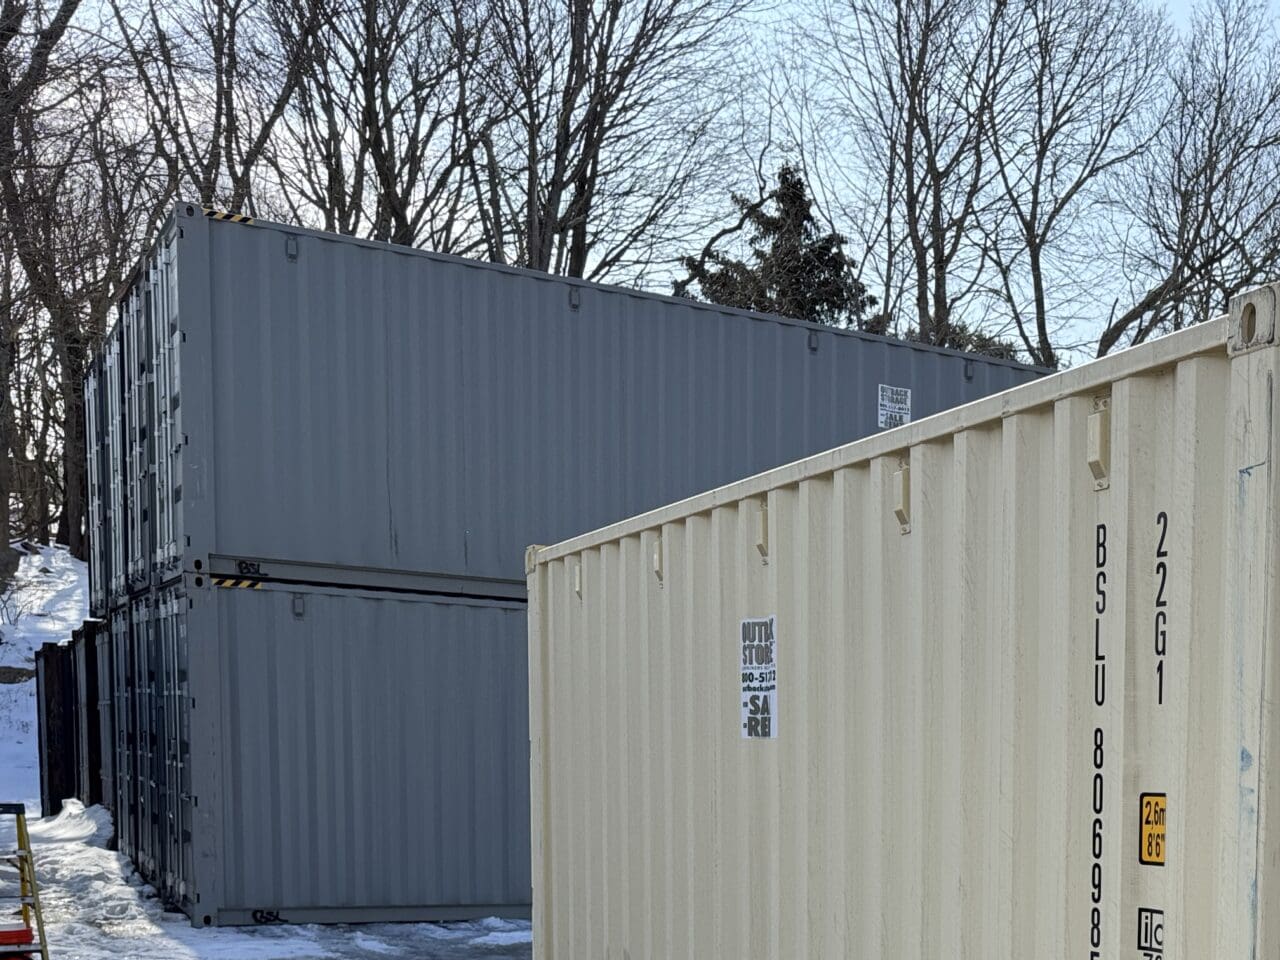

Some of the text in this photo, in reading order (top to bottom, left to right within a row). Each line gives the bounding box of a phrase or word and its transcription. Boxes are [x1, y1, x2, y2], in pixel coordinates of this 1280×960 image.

[238, 560, 269, 577] BSL
[1094, 523, 1107, 706] BSLU
[1155, 511, 1168, 704] 22G1
